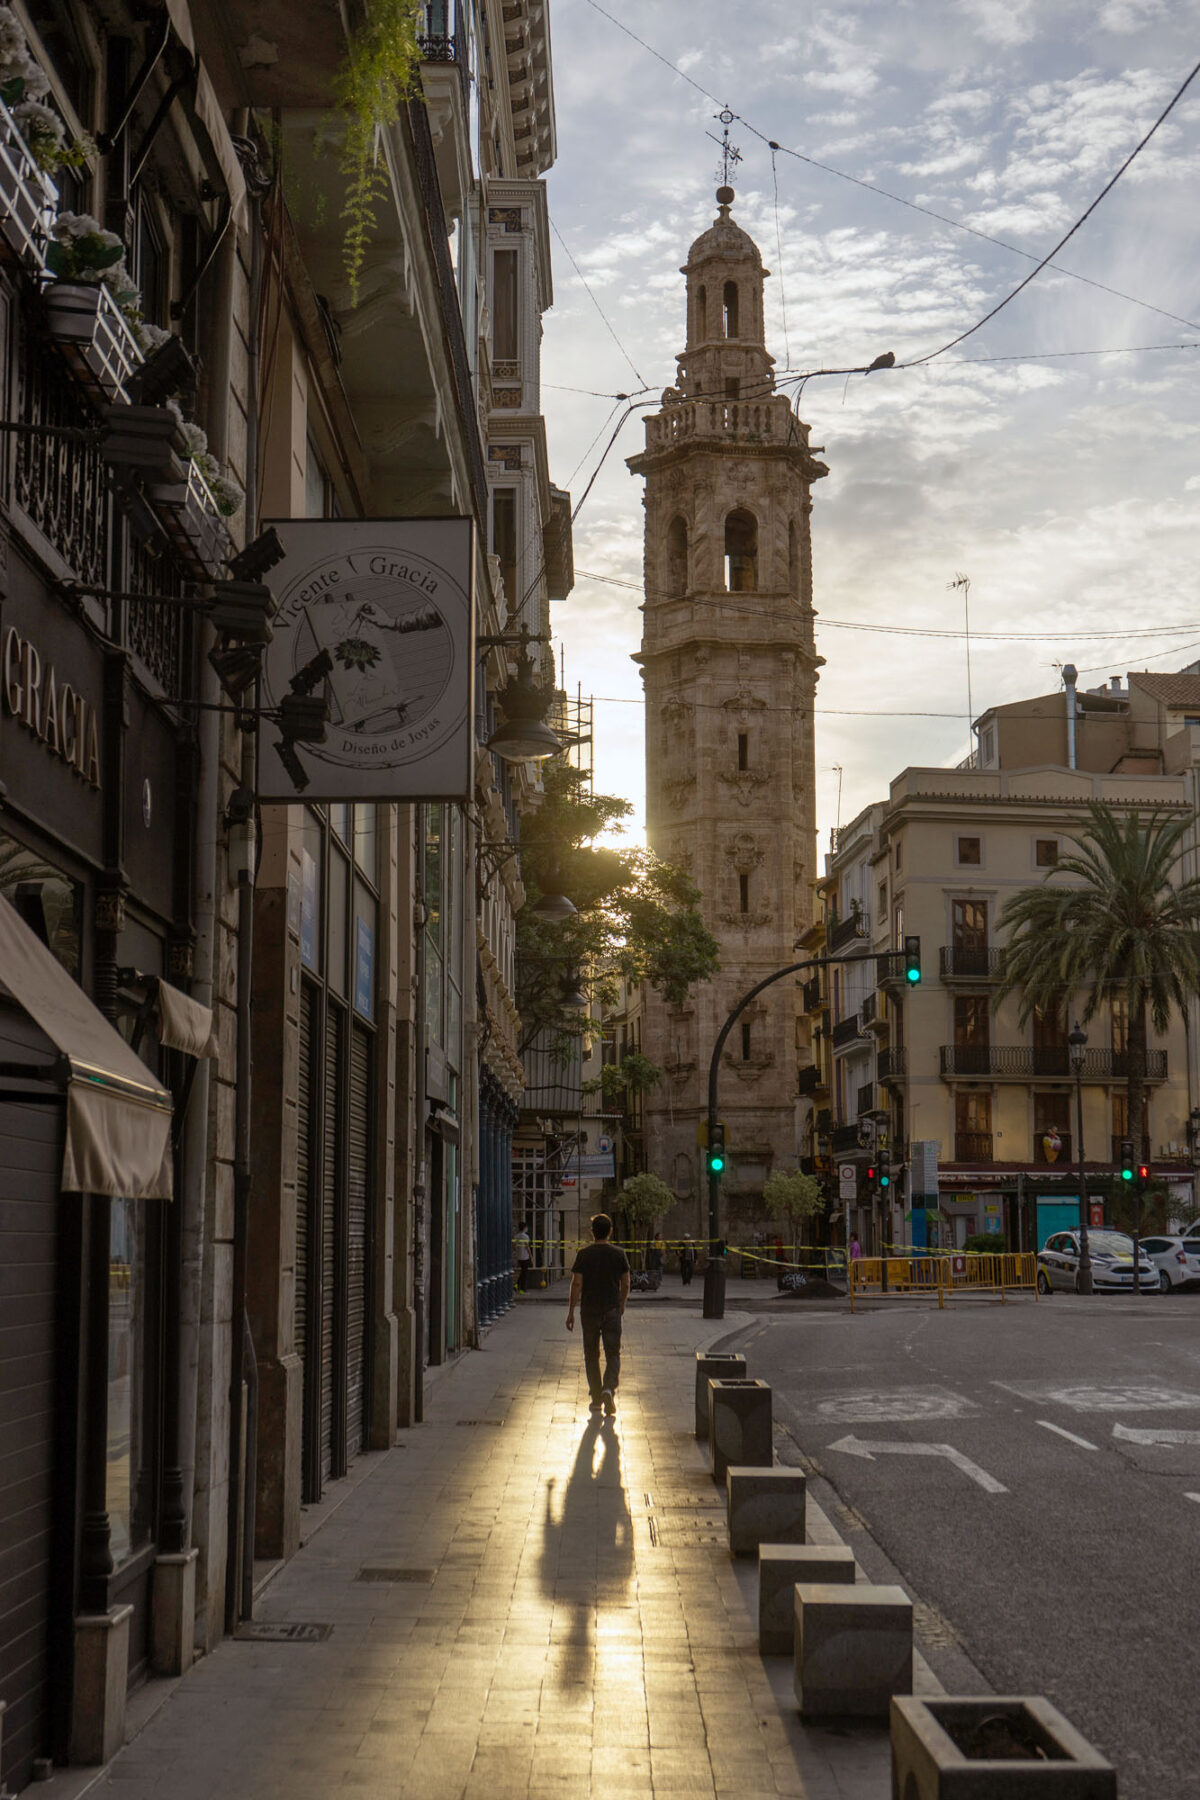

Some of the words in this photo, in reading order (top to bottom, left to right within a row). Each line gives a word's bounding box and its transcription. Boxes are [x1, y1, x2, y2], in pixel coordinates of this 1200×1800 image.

[272, 570, 340, 628] Vicente
[370, 556, 438, 594] Gracia
[4, 626, 102, 790] GRACIA
[342, 740, 388, 754] Diseño
[391, 739, 407, 751] de
[408, 718, 440, 745] Joyas
